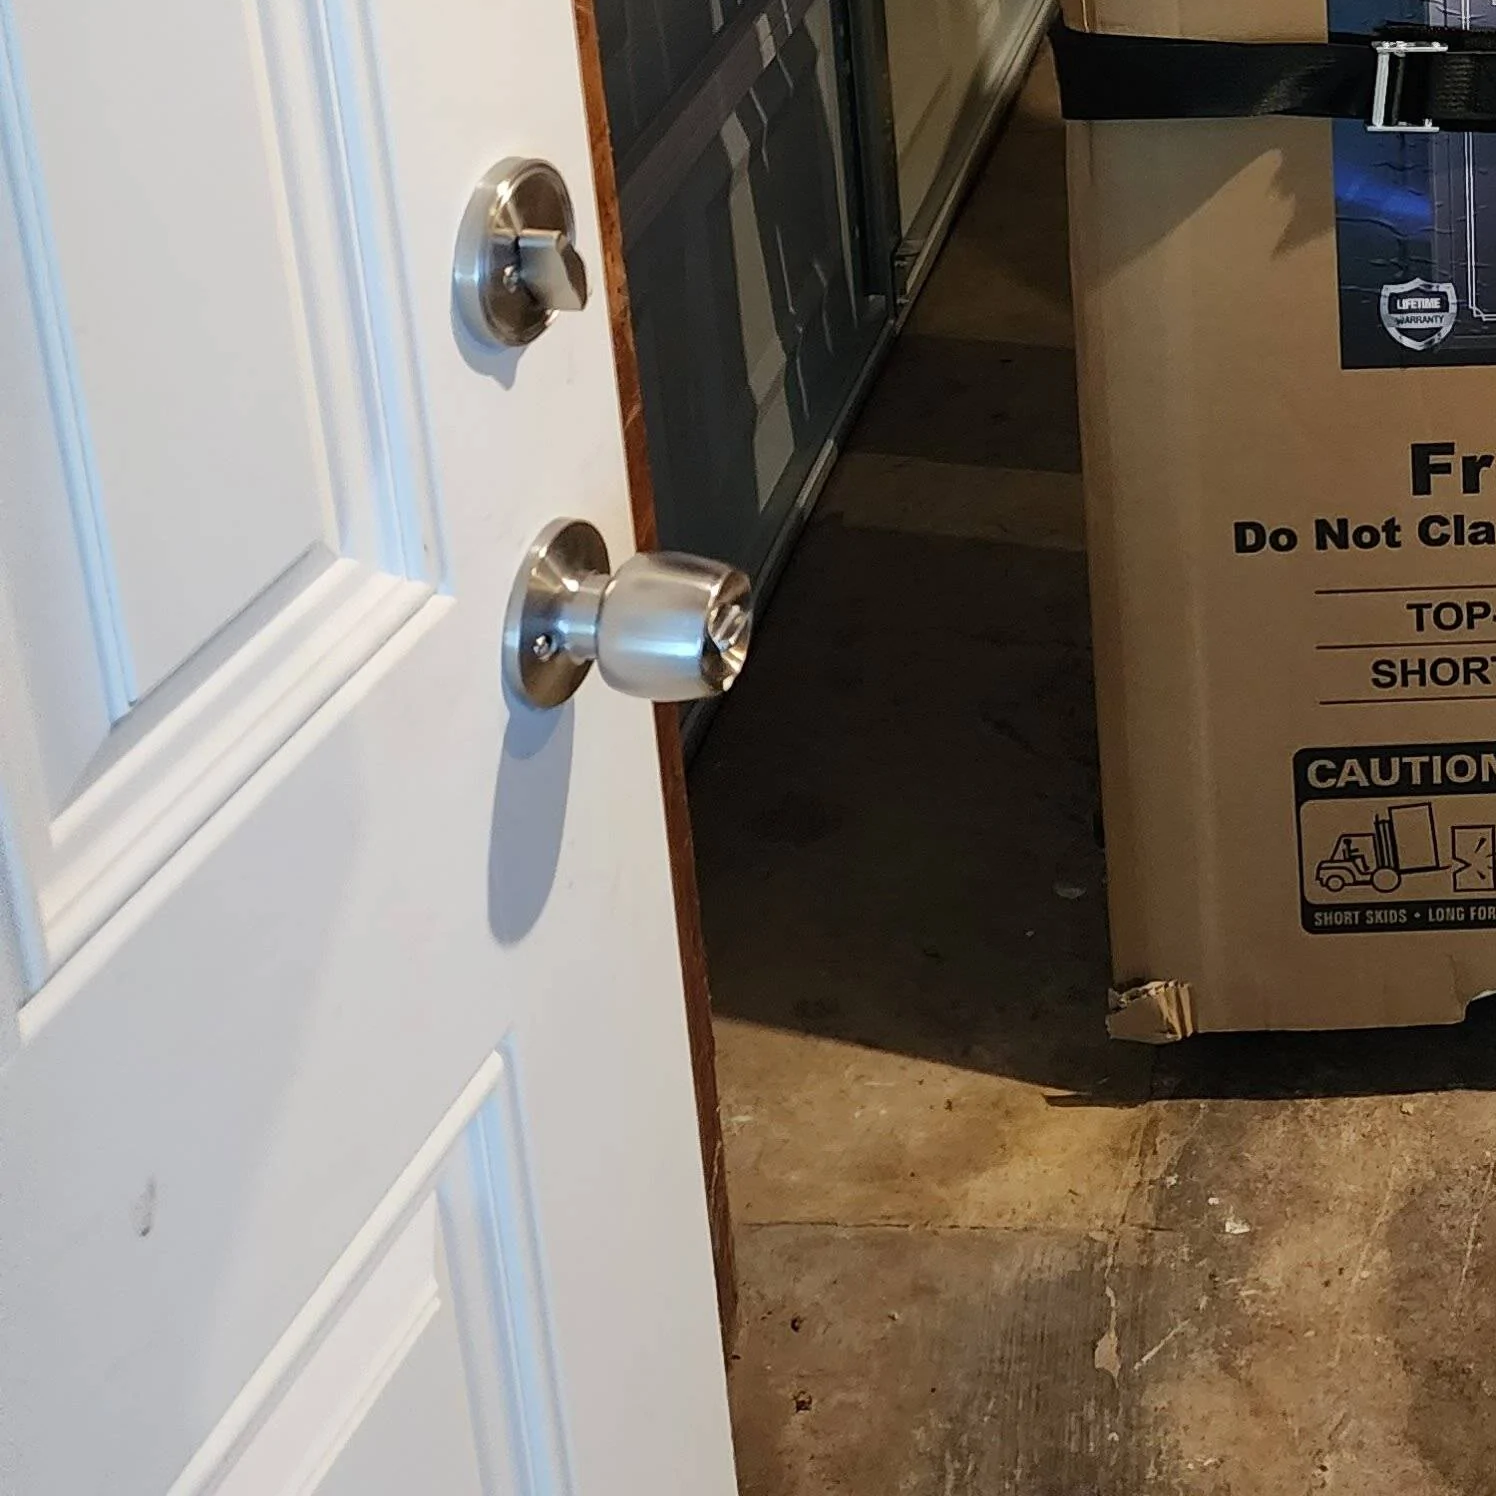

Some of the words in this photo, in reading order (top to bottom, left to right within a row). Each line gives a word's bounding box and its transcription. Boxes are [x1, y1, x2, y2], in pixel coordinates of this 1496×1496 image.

[1397, 297, 1441, 310] LIFETIME
[1396, 315, 1444, 324] WARRANTY
[1234, 522, 1298, 554] Do
[1315, 516, 1402, 550] Not
[1314, 910, 1360, 926] SHORT
[1366, 908, 1407, 924] SKIDS
[1428, 907, 1465, 922] LONG
